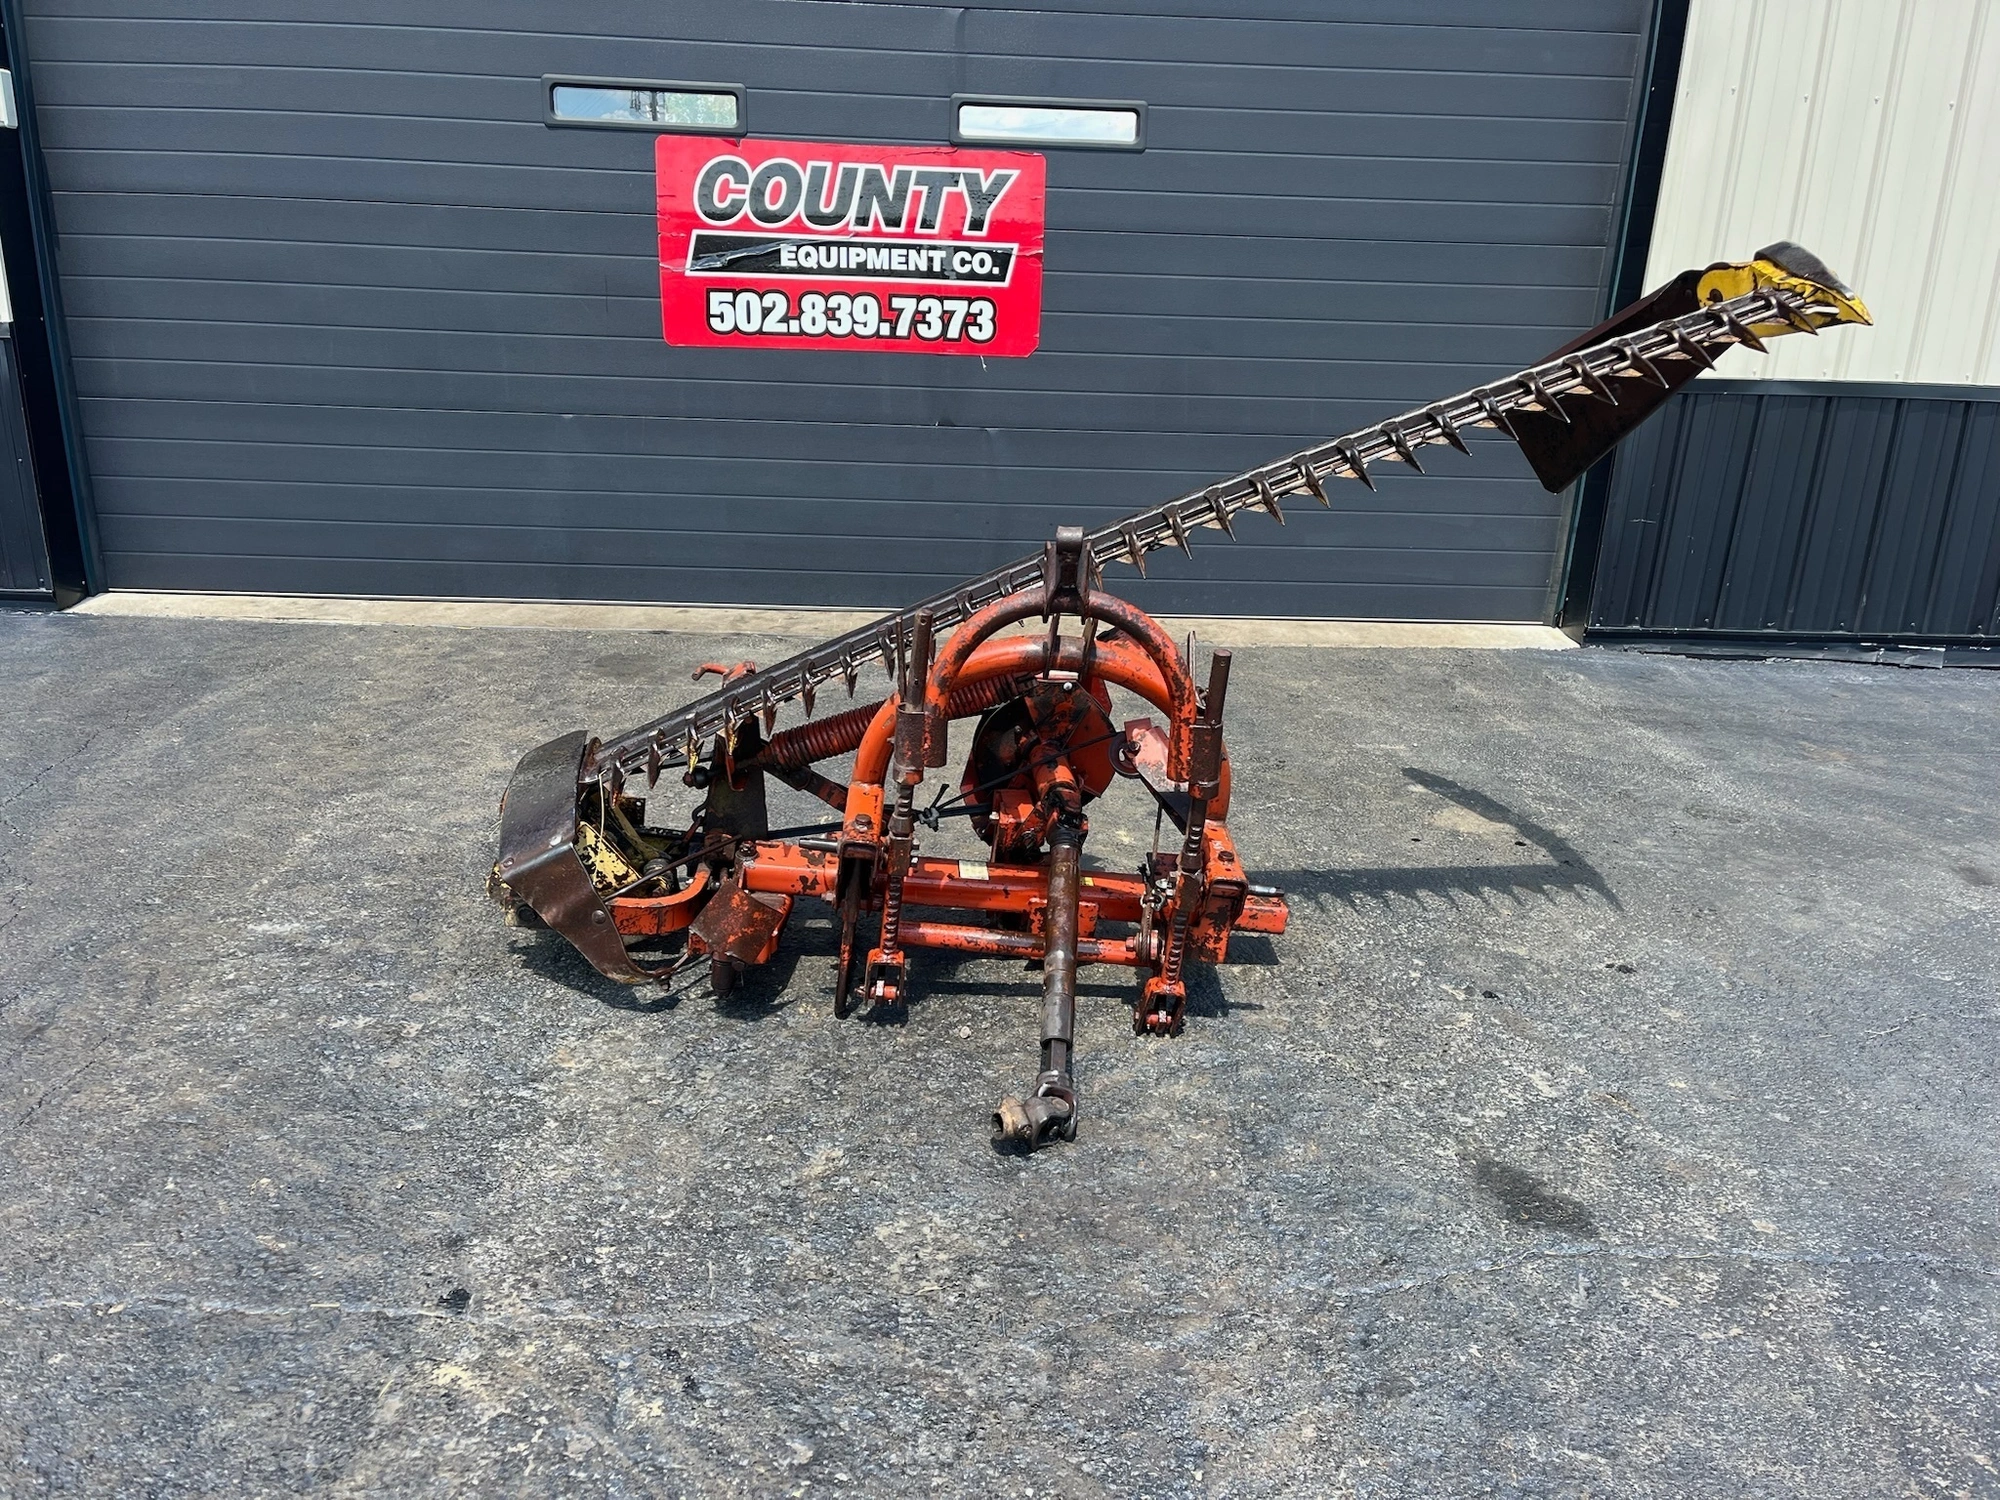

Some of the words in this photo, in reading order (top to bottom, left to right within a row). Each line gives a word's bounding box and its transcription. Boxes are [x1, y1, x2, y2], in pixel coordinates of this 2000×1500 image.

[693, 155, 1020, 236] COUNTY
[778, 243, 946, 272] EQUIPMENT
[952, 254, 1000, 275] CO.
[706, 289, 997, 342] 502.839.7373
